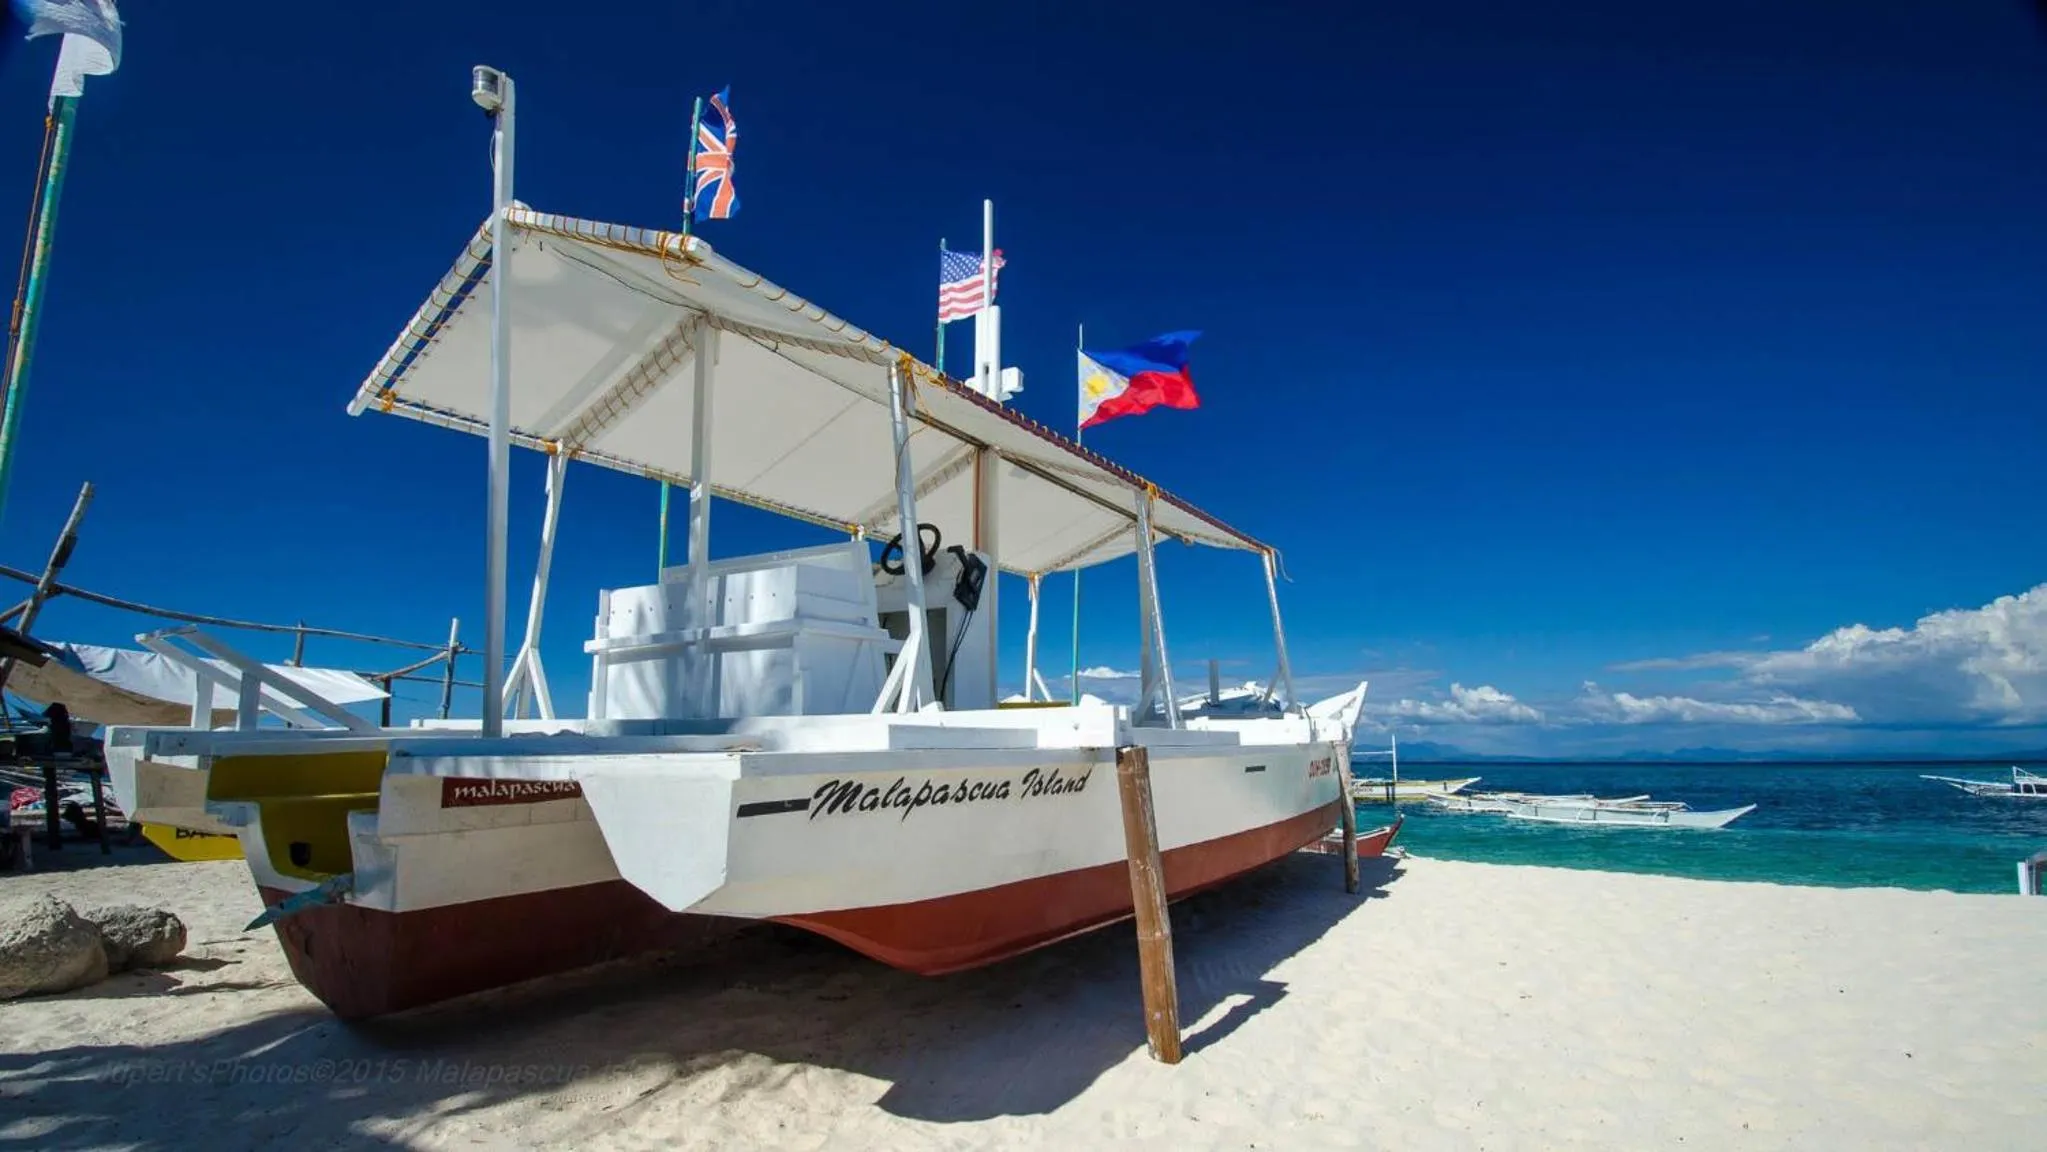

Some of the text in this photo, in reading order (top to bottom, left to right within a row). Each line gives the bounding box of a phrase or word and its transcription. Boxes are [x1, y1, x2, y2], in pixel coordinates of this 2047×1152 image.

[454, 779, 576, 799] malapascua
[809, 763, 1095, 823] Malapascua Island
